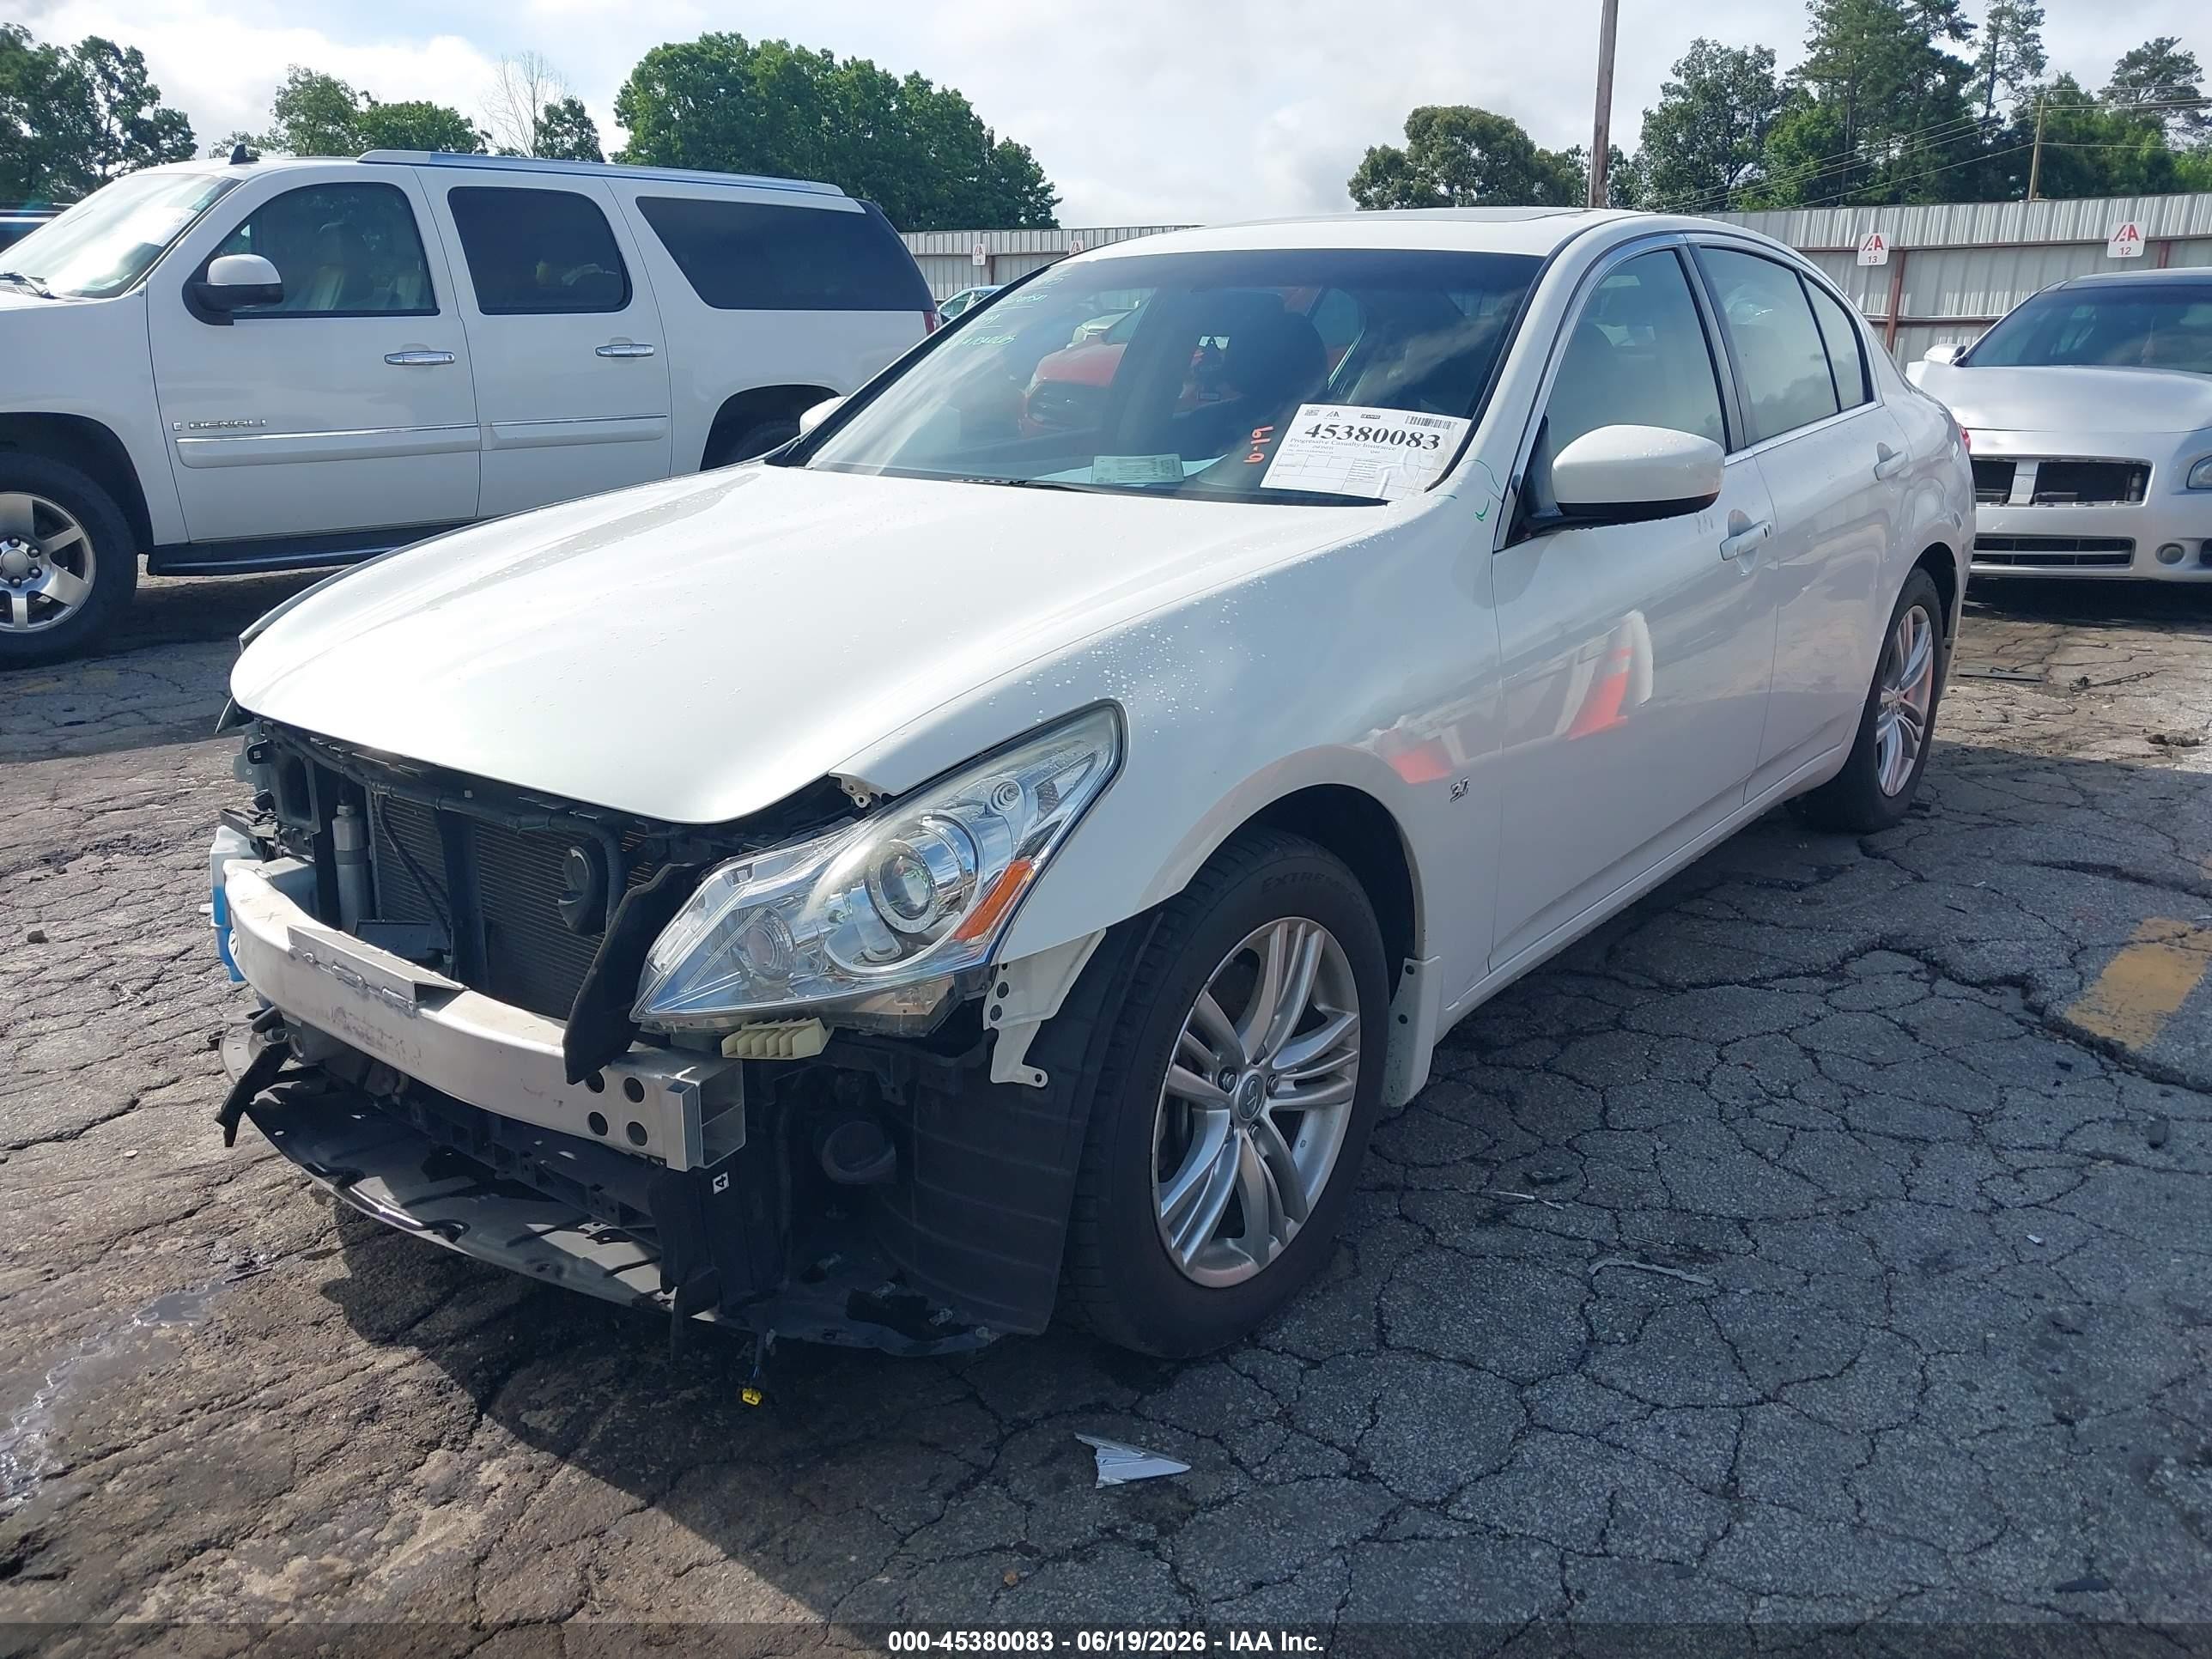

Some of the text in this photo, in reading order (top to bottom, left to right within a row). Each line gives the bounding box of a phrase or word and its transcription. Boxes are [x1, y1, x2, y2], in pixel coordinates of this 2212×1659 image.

[2119, 246, 2132, 256] 12
[1868, 255, 1878, 264] 13
[189, 418, 266, 430] DENALI
[1304, 422, 1441, 451] 45380083
[1362, 442, 1397, 451] Insurance
